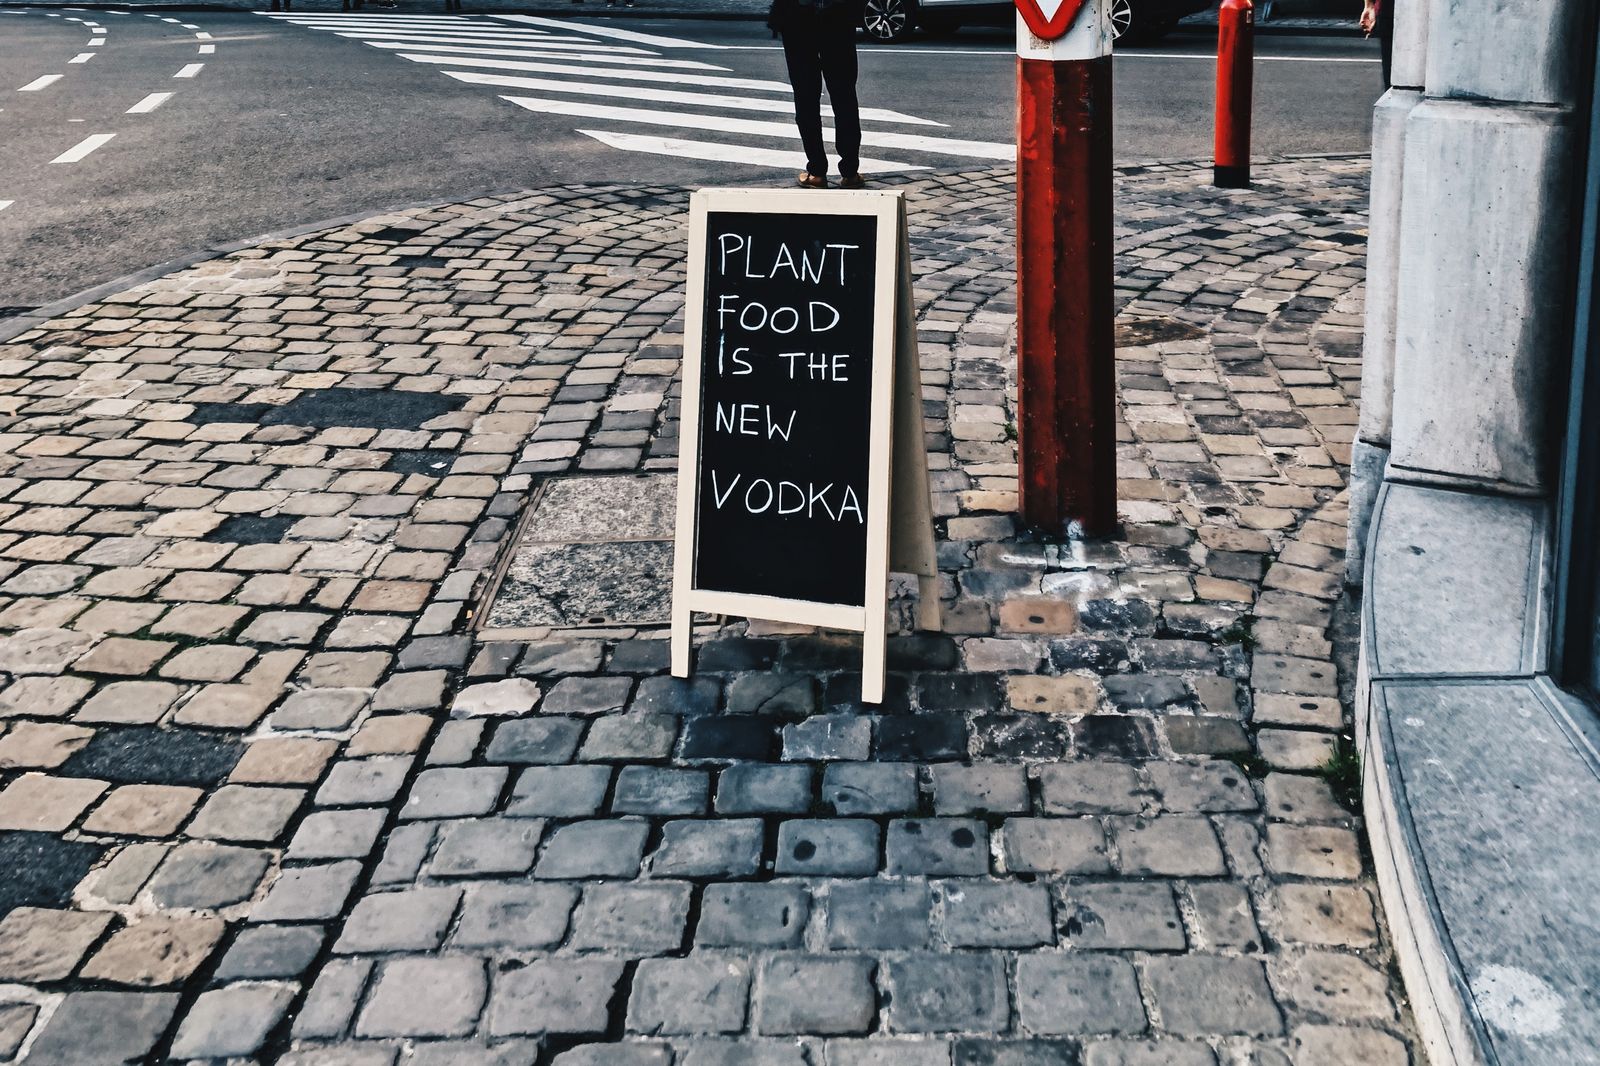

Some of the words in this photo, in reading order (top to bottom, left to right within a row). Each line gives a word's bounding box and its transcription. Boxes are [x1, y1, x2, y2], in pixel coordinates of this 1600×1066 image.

[718, 232, 860, 286] PLANT
[717, 294, 841, 334] FOOD
[718, 332, 753, 378] IS
[779, 352, 850, 382] THE
[715, 401, 797, 442] NEW
[711, 469, 864, 524] VODKA
